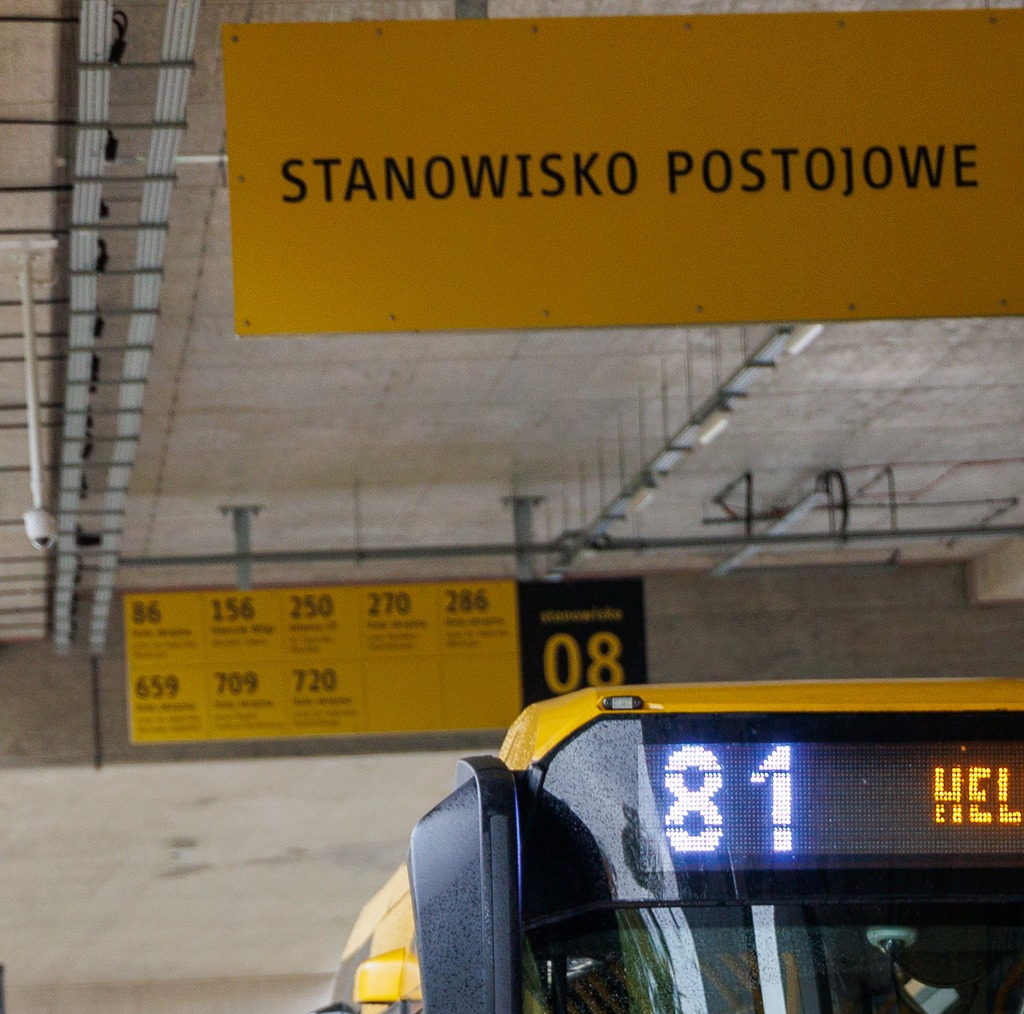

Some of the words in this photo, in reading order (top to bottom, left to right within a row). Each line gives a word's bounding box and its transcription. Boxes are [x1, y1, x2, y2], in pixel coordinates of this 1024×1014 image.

[281, 151, 640, 203] STANOWISKO
[668, 143, 980, 195] POSTOJOWE
[132, 601, 162, 624] 86
[212, 597, 255, 621] 156
[367, 591, 411, 616] 270
[445, 588, 490, 613] 286
[543, 631, 625, 694] 08
[136, 674, 180, 698] 659
[215, 670, 259, 695] 709
[293, 667, 337, 692] 720
[663, 744, 794, 853] 81
